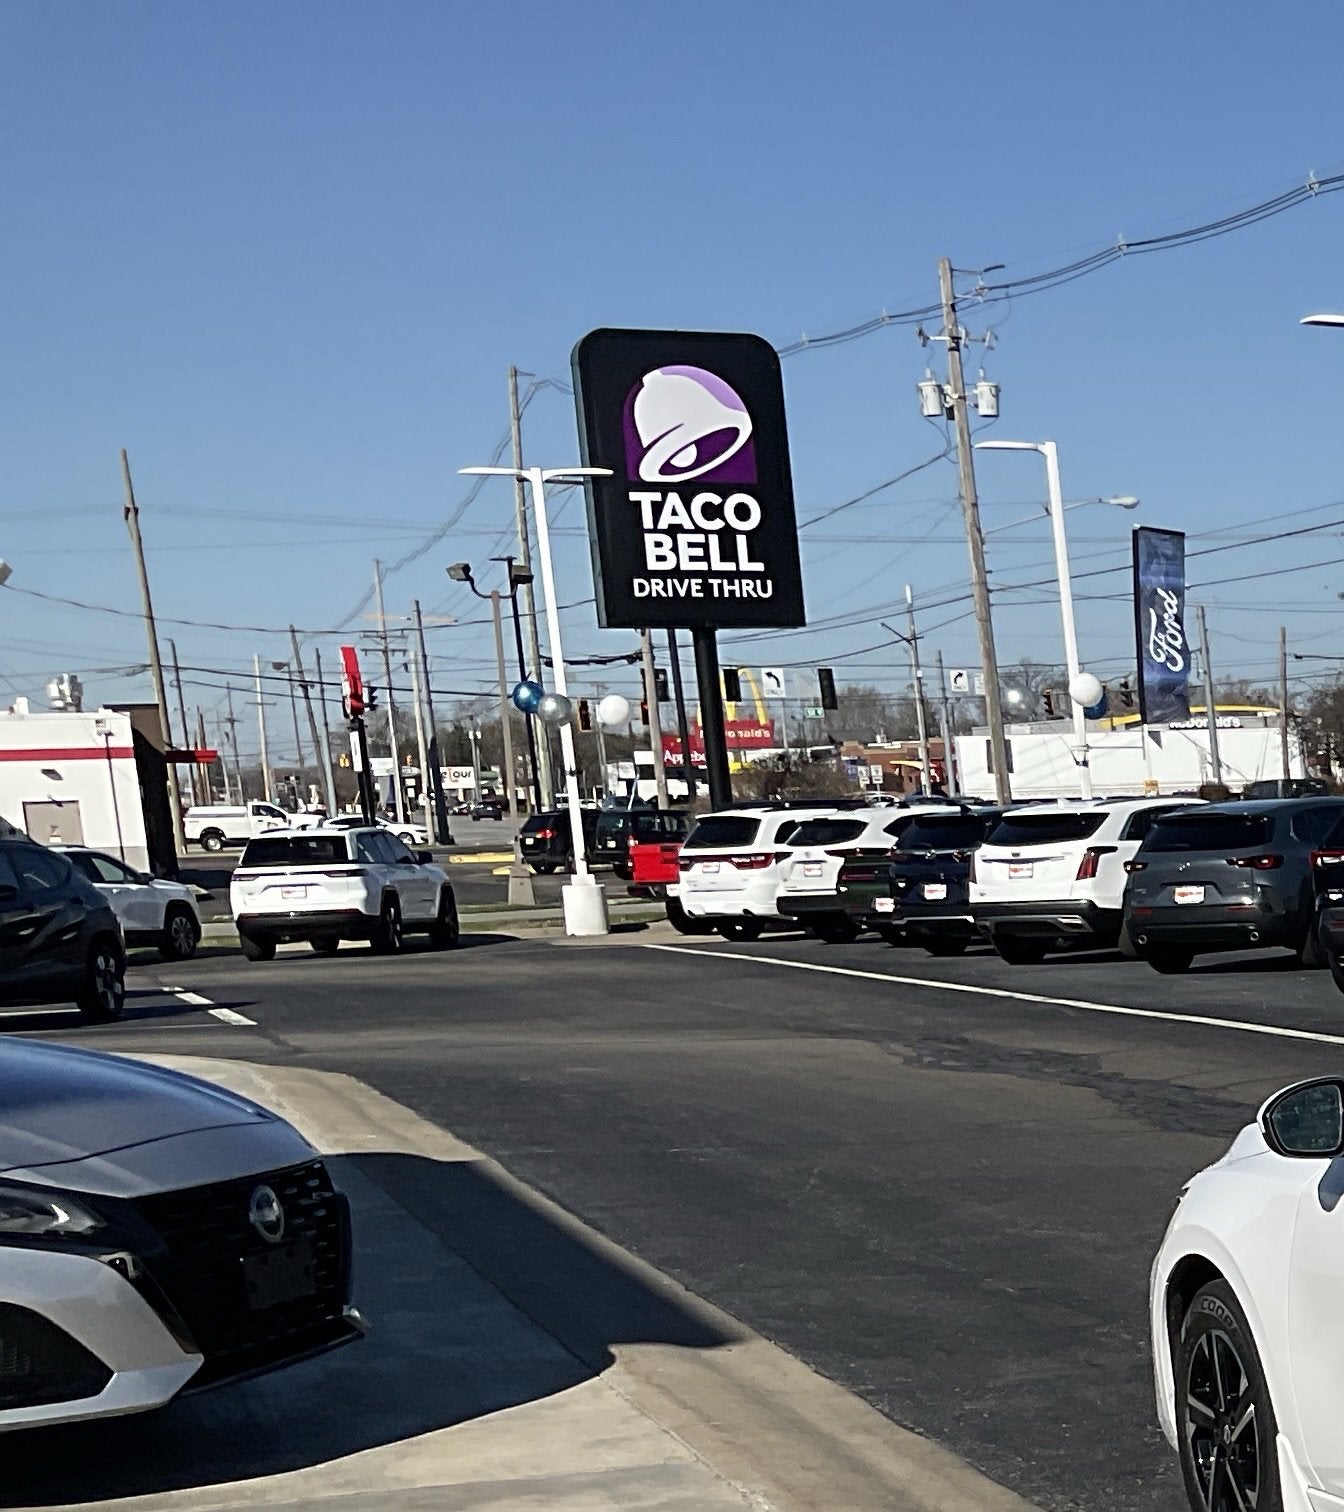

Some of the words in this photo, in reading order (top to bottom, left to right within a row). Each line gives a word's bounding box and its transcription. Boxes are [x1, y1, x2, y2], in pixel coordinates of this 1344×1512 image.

[628, 491, 761, 531] TACO
[643, 533, 765, 571] BELL
[633, 578, 704, 598] DRIVE
[707, 579, 773, 599] THRU
[1149, 588, 1185, 673] Ford
